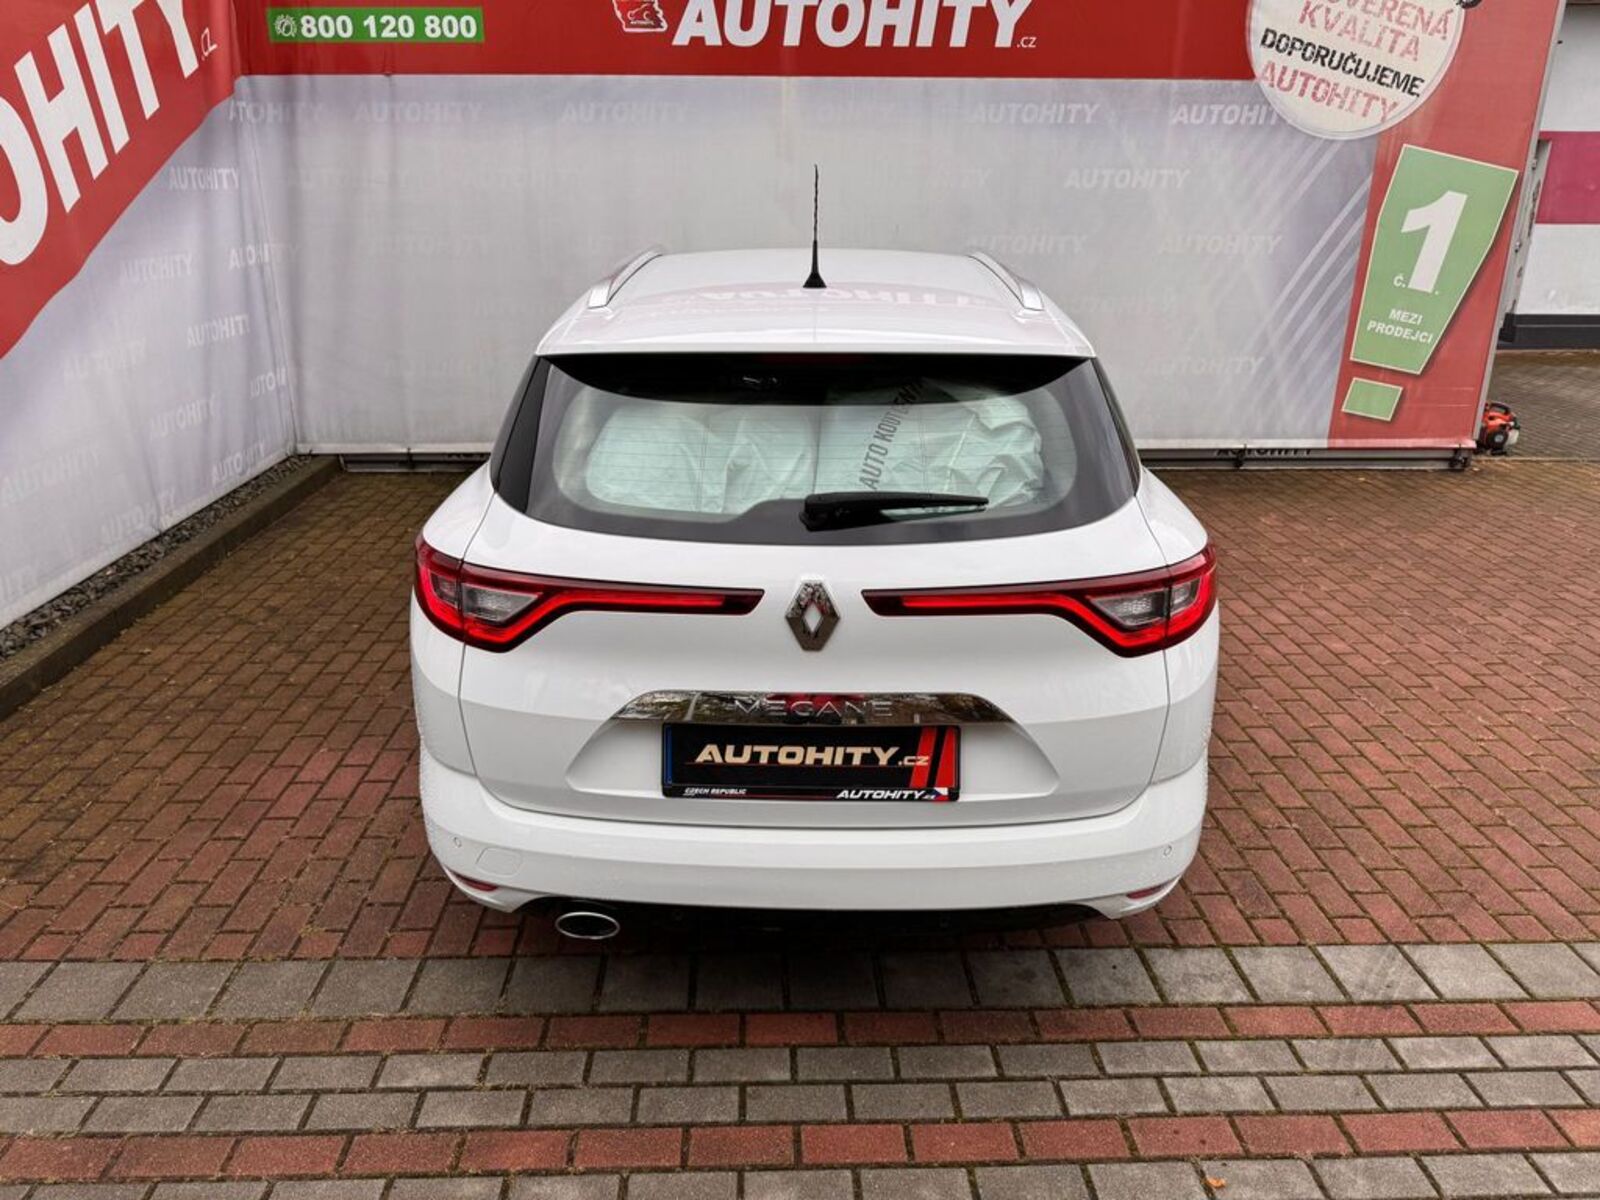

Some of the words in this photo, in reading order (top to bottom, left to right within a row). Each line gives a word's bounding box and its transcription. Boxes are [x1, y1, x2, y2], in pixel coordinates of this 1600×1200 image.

[301, 15, 353, 38] 800
[363, 15, 415, 38] 120
[424, 15, 477, 38] 800
[1299, 1, 1420, 62] KVALITA
[1260, 27, 1425, 98] DOPORUČUJEME
[1262, 60, 1400, 124] AUTOHITY
[353, 101, 484, 124] AUTOHITY
[561, 101, 691, 124] AUTOHITY
[972, 103, 1101, 125] AUTOHITY
[168, 167, 240, 190] AUTOHITY
[1064, 168, 1191, 190] AUTOHITY
[1158, 234, 1283, 256] AUTOHITY
[120, 252, 195, 285] AUTOHITY
[1389, 308, 1423, 326] MEZI
[1366, 319, 1434, 344] PRODEJCI
[859, 443, 888, 490] AUTO
[734, 699, 893, 718] MEGANE
